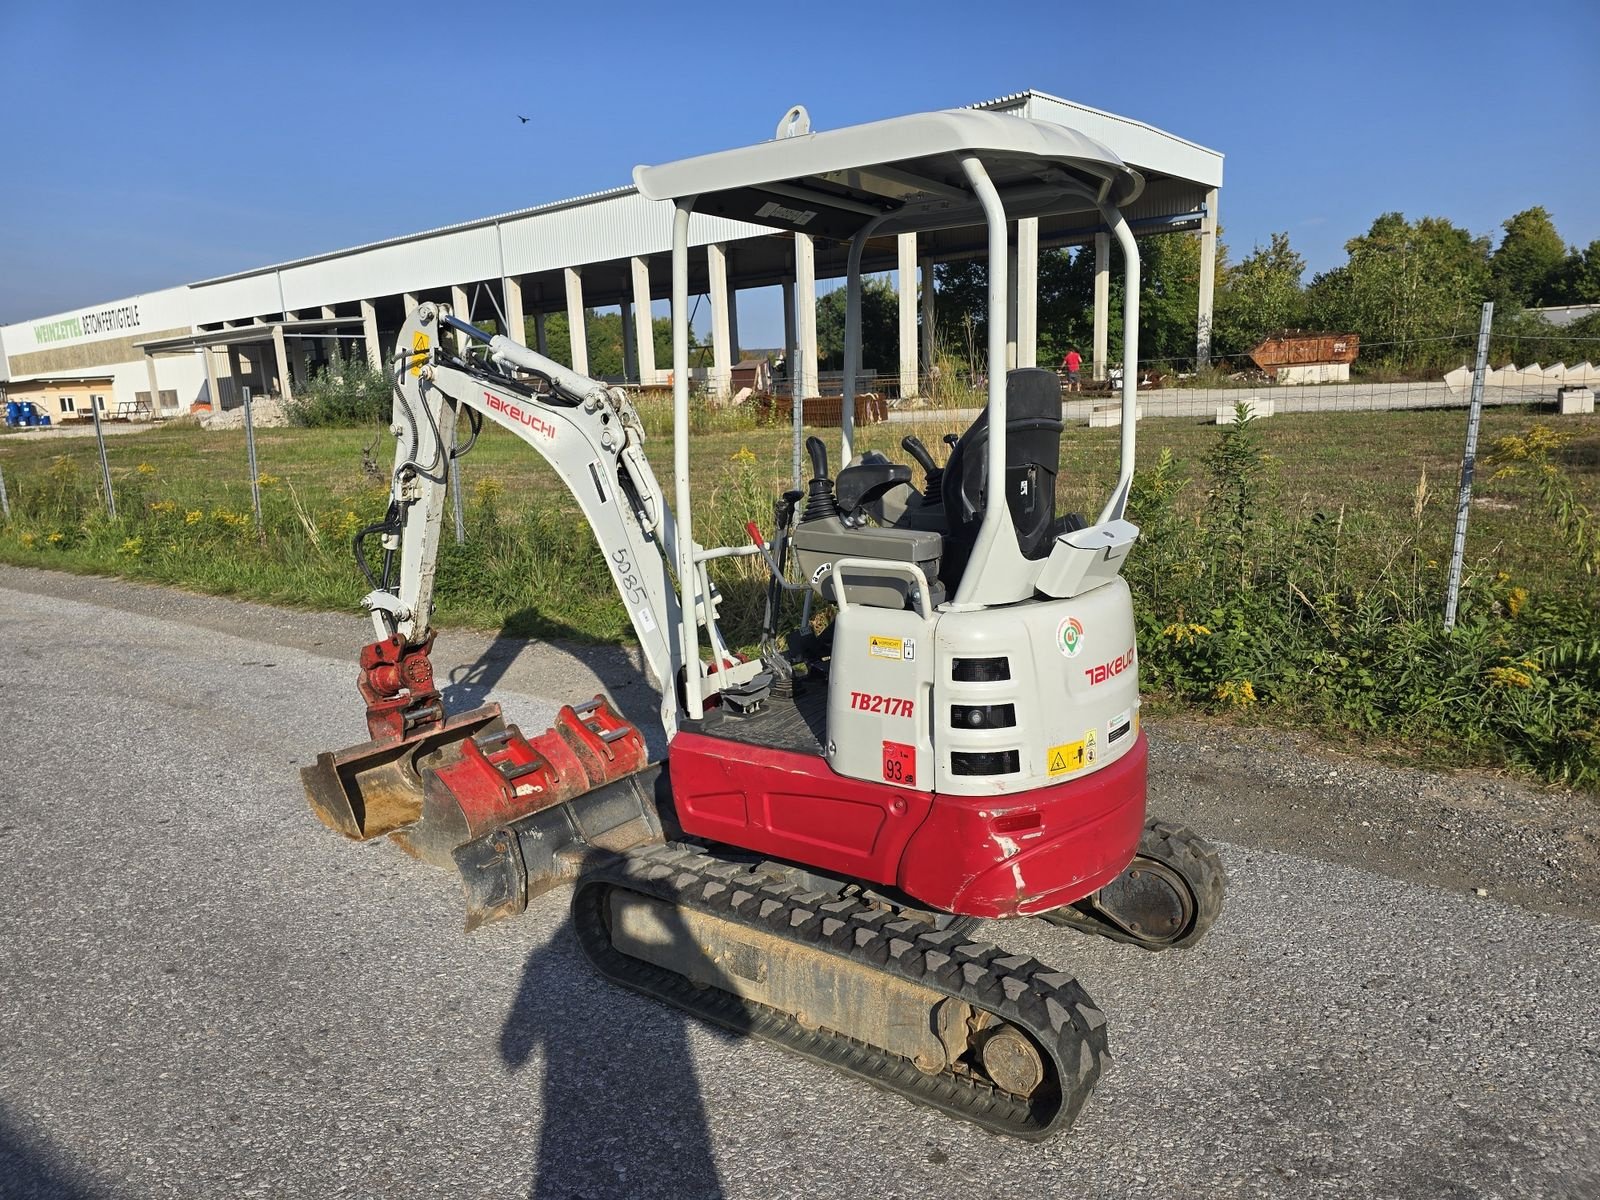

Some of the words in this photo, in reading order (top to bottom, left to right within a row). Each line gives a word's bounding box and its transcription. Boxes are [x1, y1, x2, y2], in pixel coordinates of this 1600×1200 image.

[484, 392, 555, 438] TAKEUCHI
[612, 548, 647, 604] 5085
[1085, 647, 1134, 685] TAKEUC
[851, 692, 914, 718] TB217R
[886, 759, 902, 780] 93
